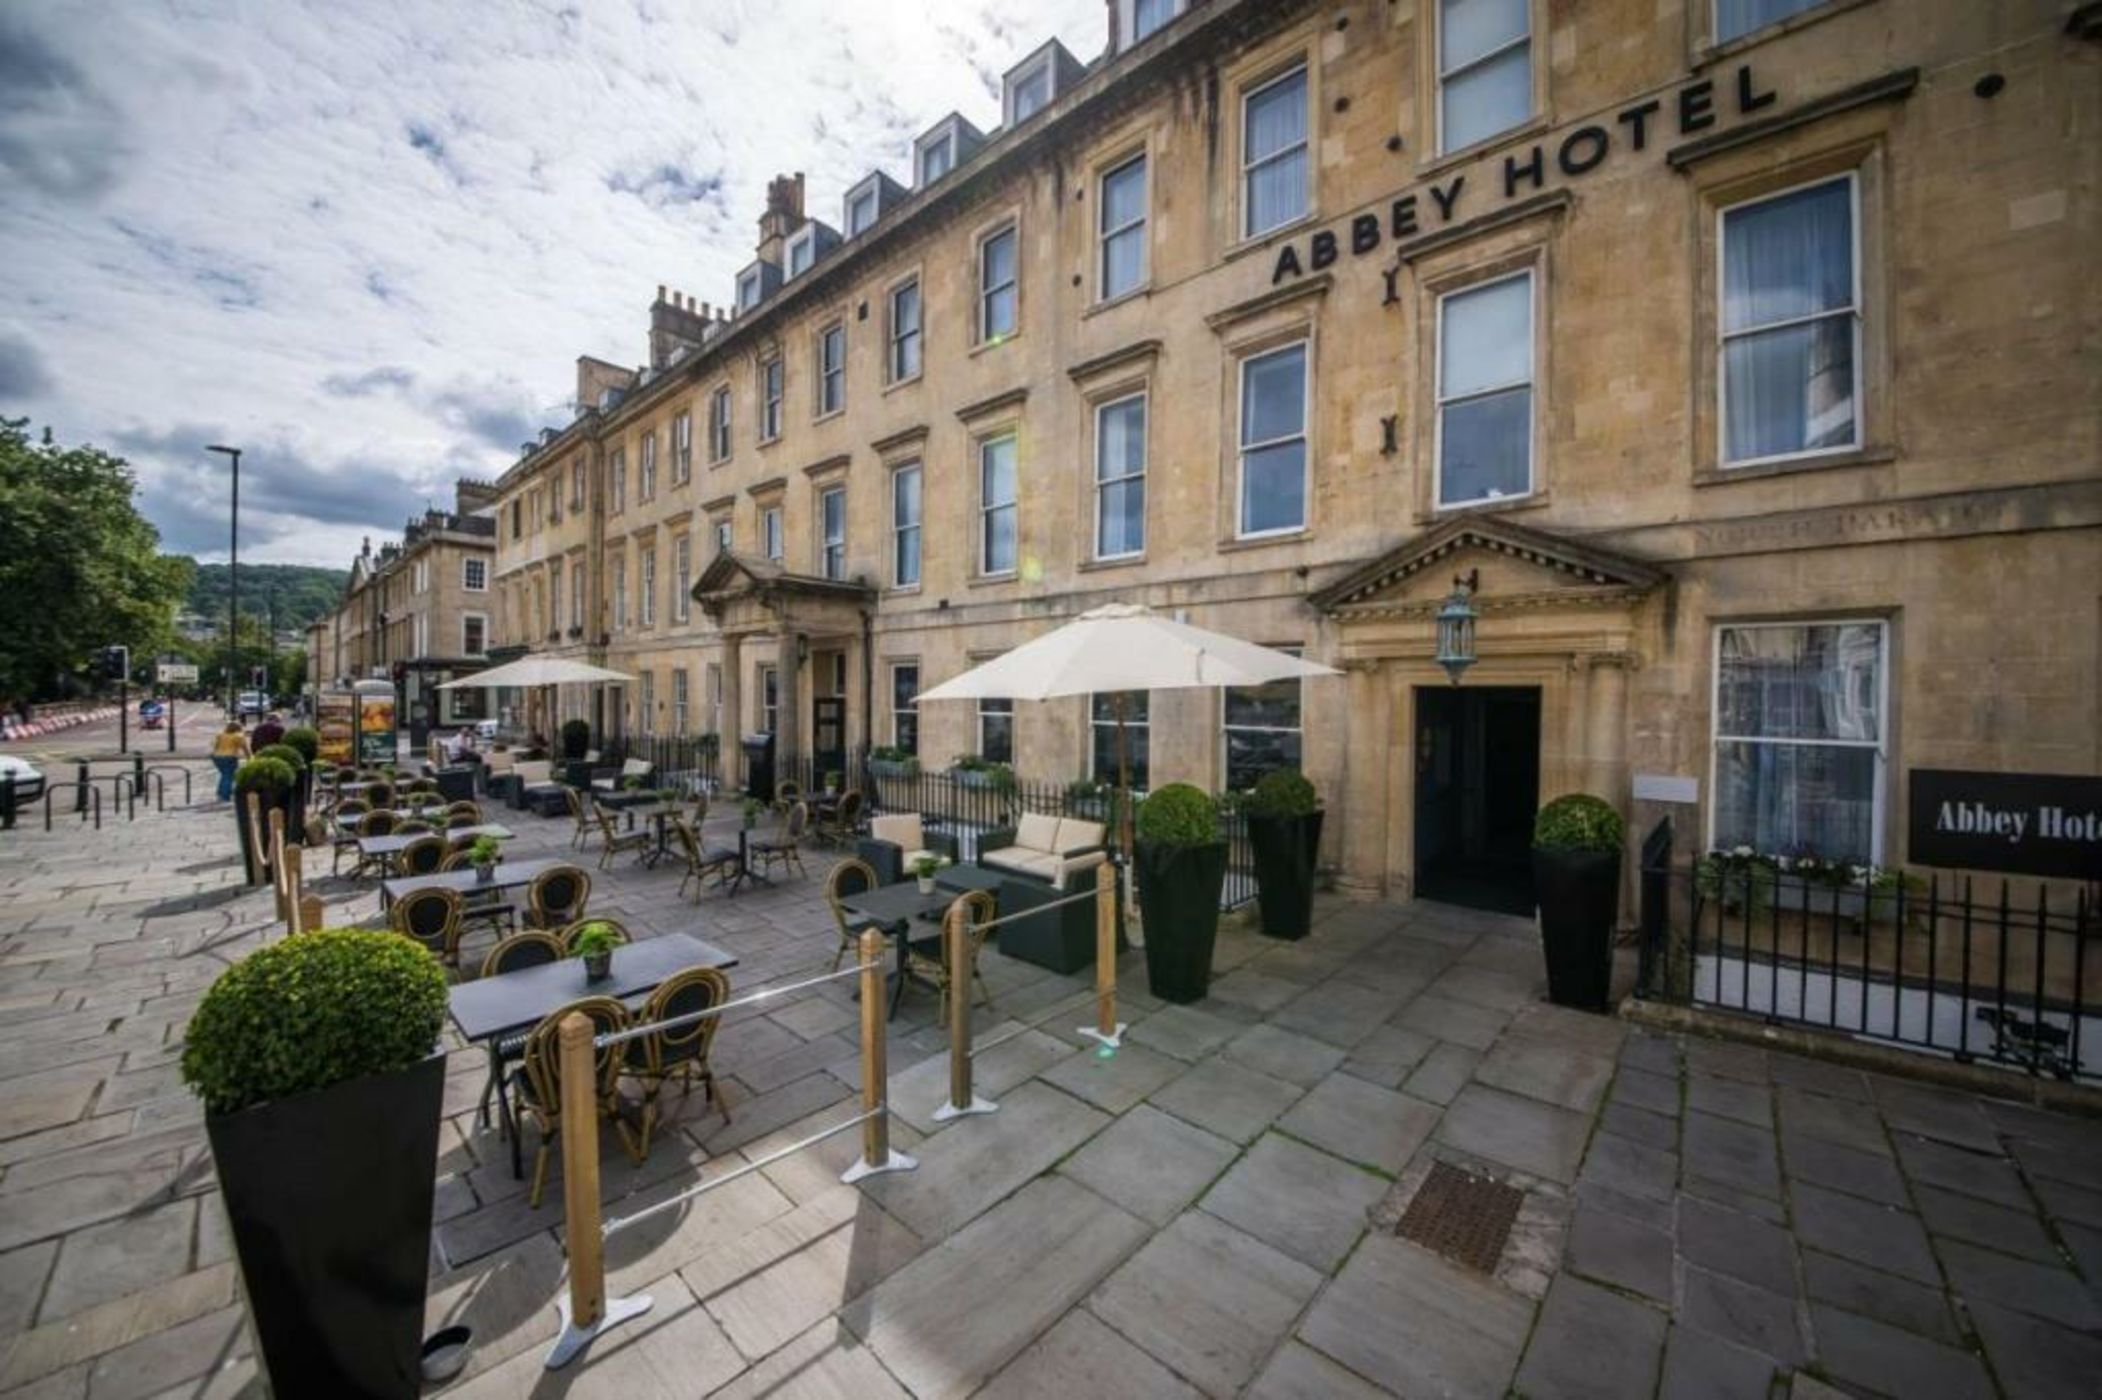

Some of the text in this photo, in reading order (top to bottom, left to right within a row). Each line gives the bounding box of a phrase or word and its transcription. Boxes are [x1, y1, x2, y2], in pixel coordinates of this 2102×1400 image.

[1272, 65, 1777, 285] ABBEY HOTEL
[1936, 801, 2102, 843] Abbey Hot
